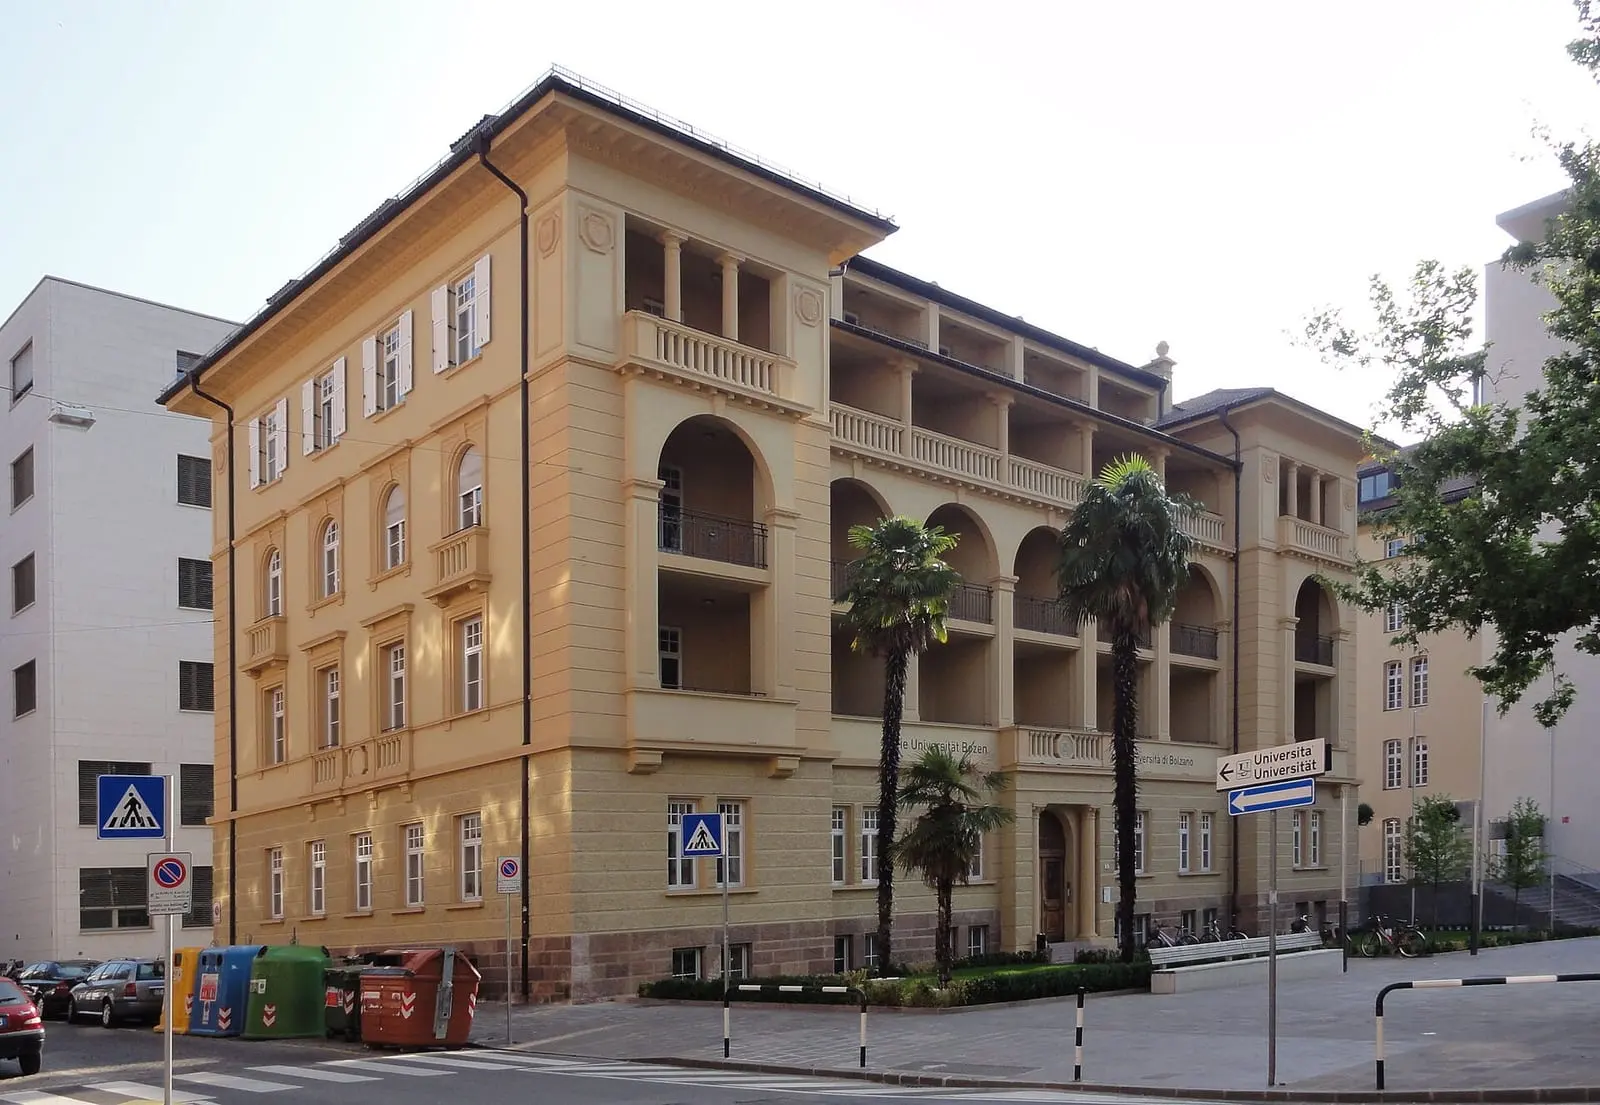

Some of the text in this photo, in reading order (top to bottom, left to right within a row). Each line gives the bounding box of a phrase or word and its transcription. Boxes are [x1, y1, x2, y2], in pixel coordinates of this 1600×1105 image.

[961, 741, 988, 754] Bozen
[1170, 755, 1193, 767] Bolzano
[1254, 760, 1317, 779] Universität
